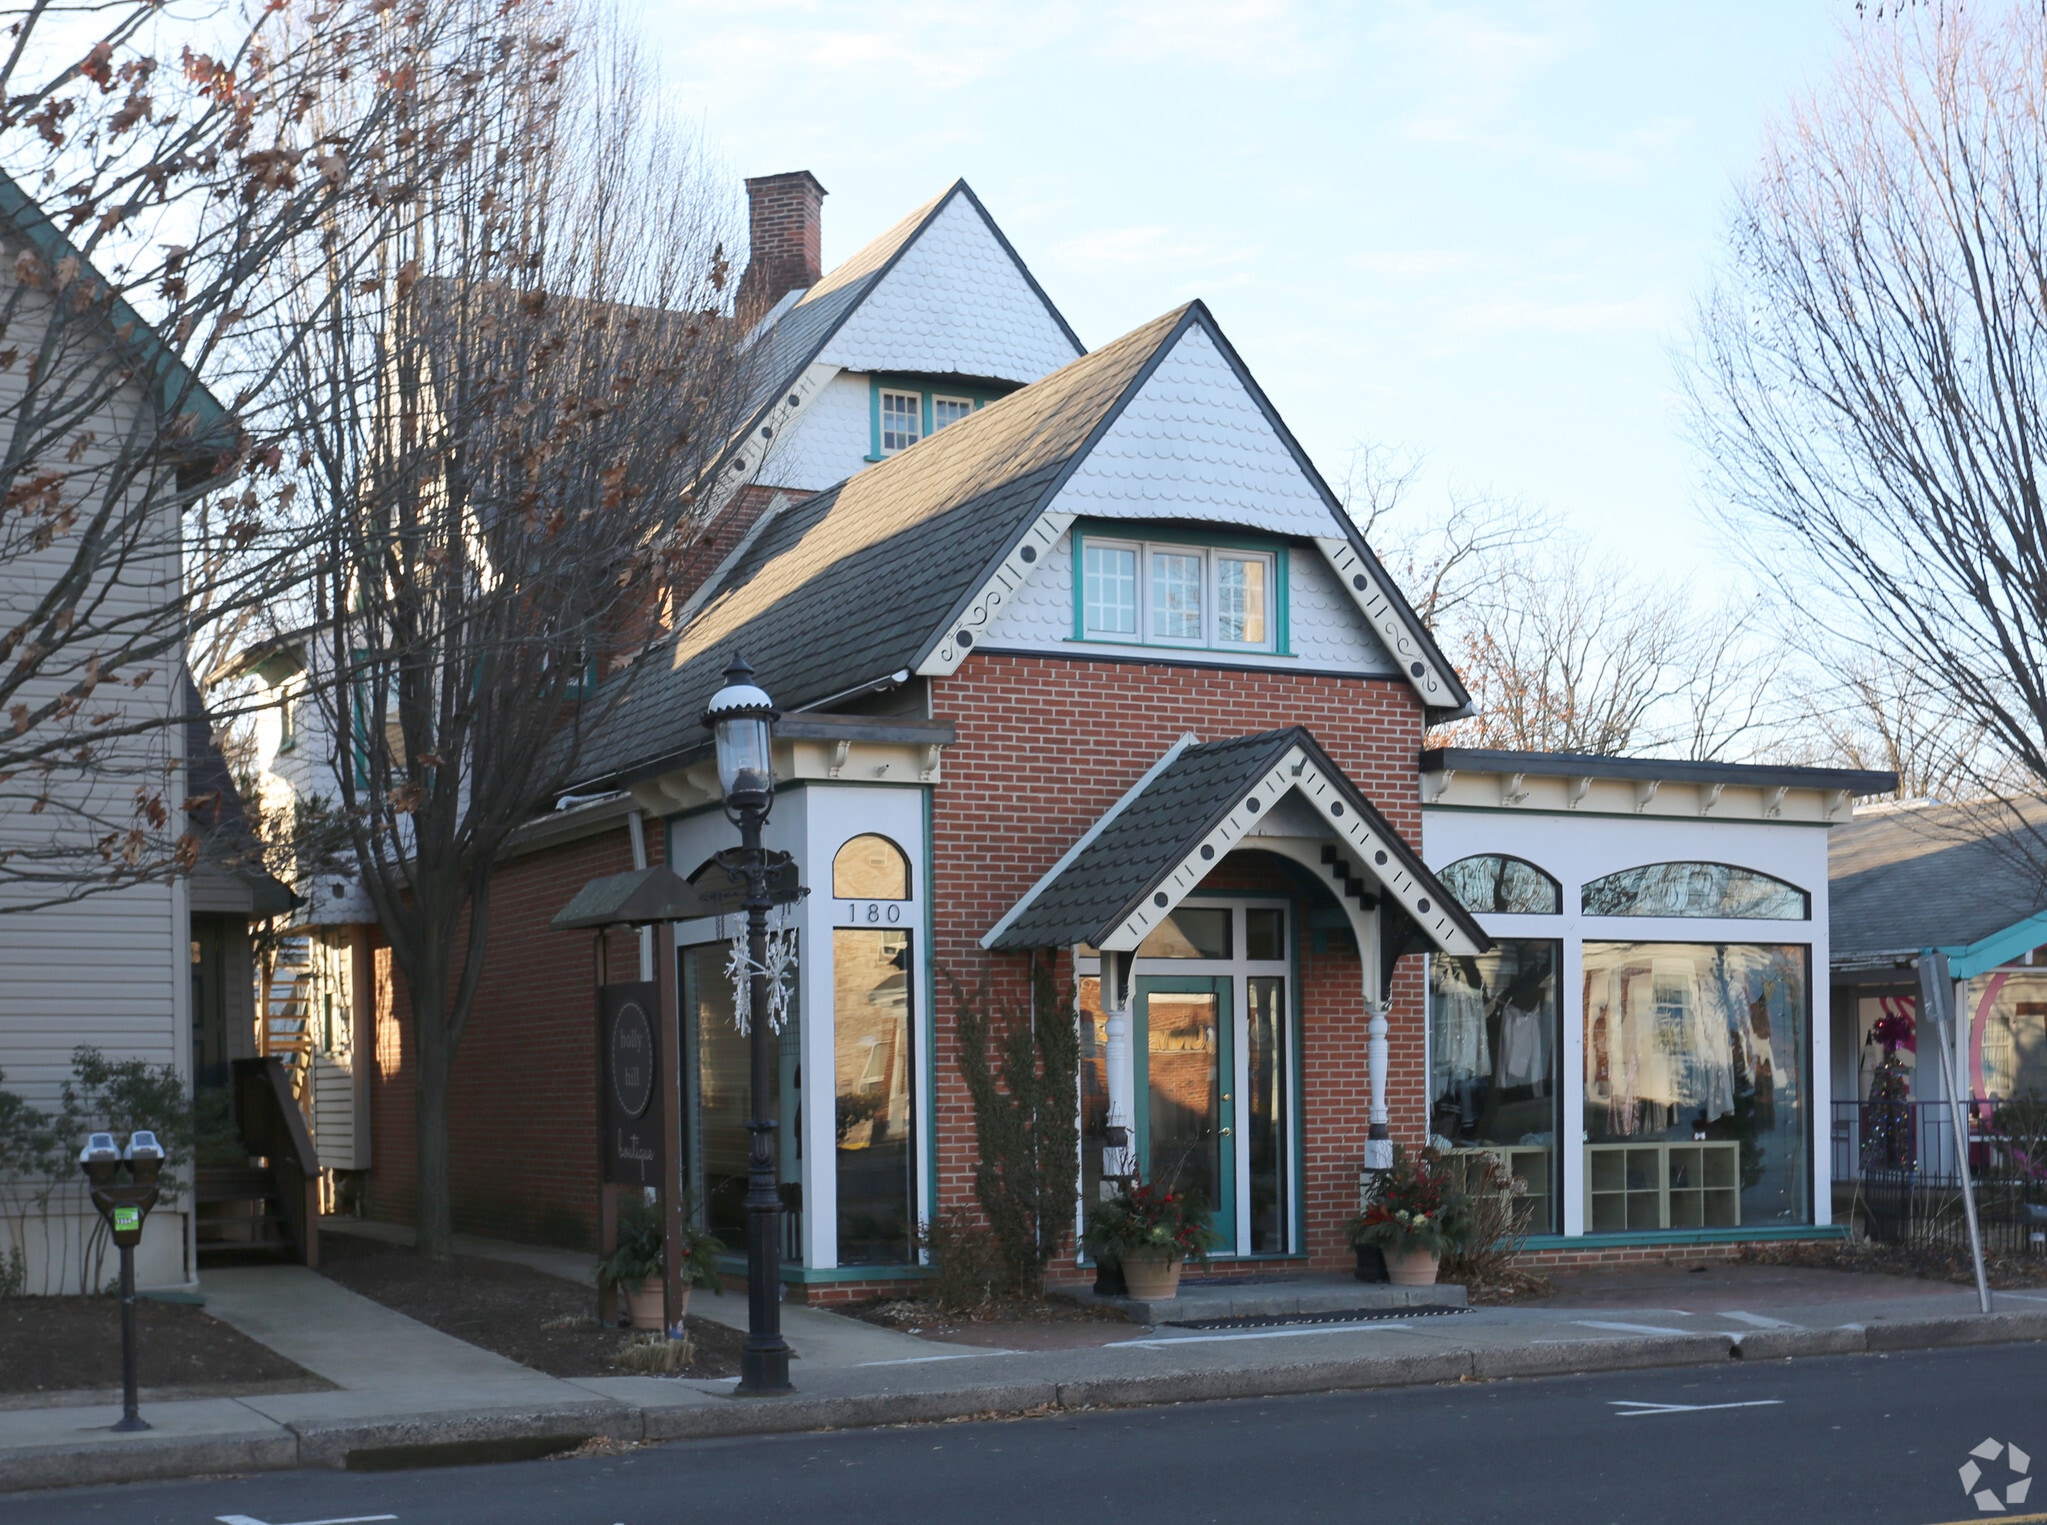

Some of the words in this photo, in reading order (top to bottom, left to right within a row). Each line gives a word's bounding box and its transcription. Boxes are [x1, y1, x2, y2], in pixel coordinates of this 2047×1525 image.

[850, 903, 900, 923] 180
[620, 1028, 642, 1053] holly
[624, 1066, 640, 1087] hill
[618, 1127, 654, 1181] boutique
